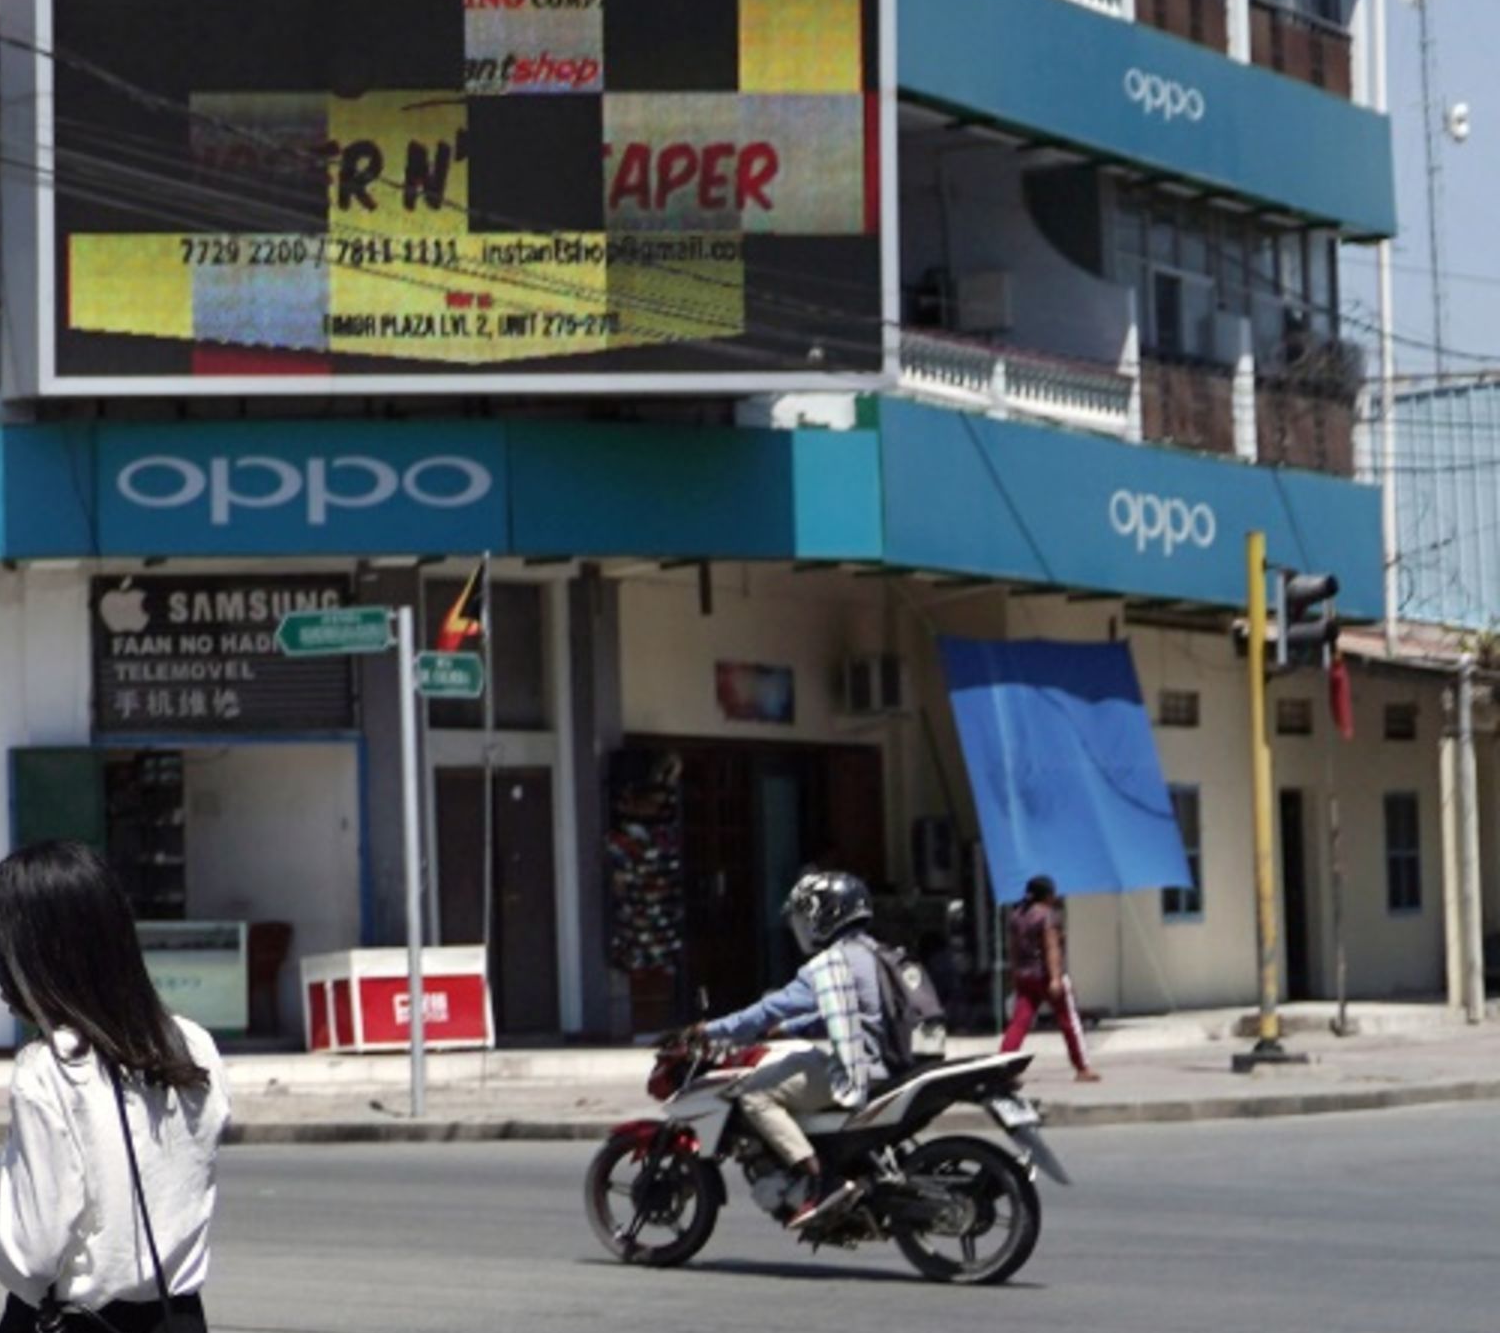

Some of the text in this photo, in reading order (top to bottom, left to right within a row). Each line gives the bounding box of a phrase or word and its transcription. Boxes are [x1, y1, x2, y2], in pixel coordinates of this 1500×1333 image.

[1123, 68, 1205, 121] oppo
[604, 142, 780, 212] APER
[180, 238, 241, 265] 7729
[249, 238, 308, 265] 2200
[380, 315, 434, 338] PLAZA
[475, 316, 494, 341] 2,
[116, 455, 492, 524] oppo
[1108, 489, 1216, 556] oppo
[113, 634, 173, 655] FAAN
[179, 634, 213, 655] NO
[116, 660, 256, 682] TELEMOVEL
